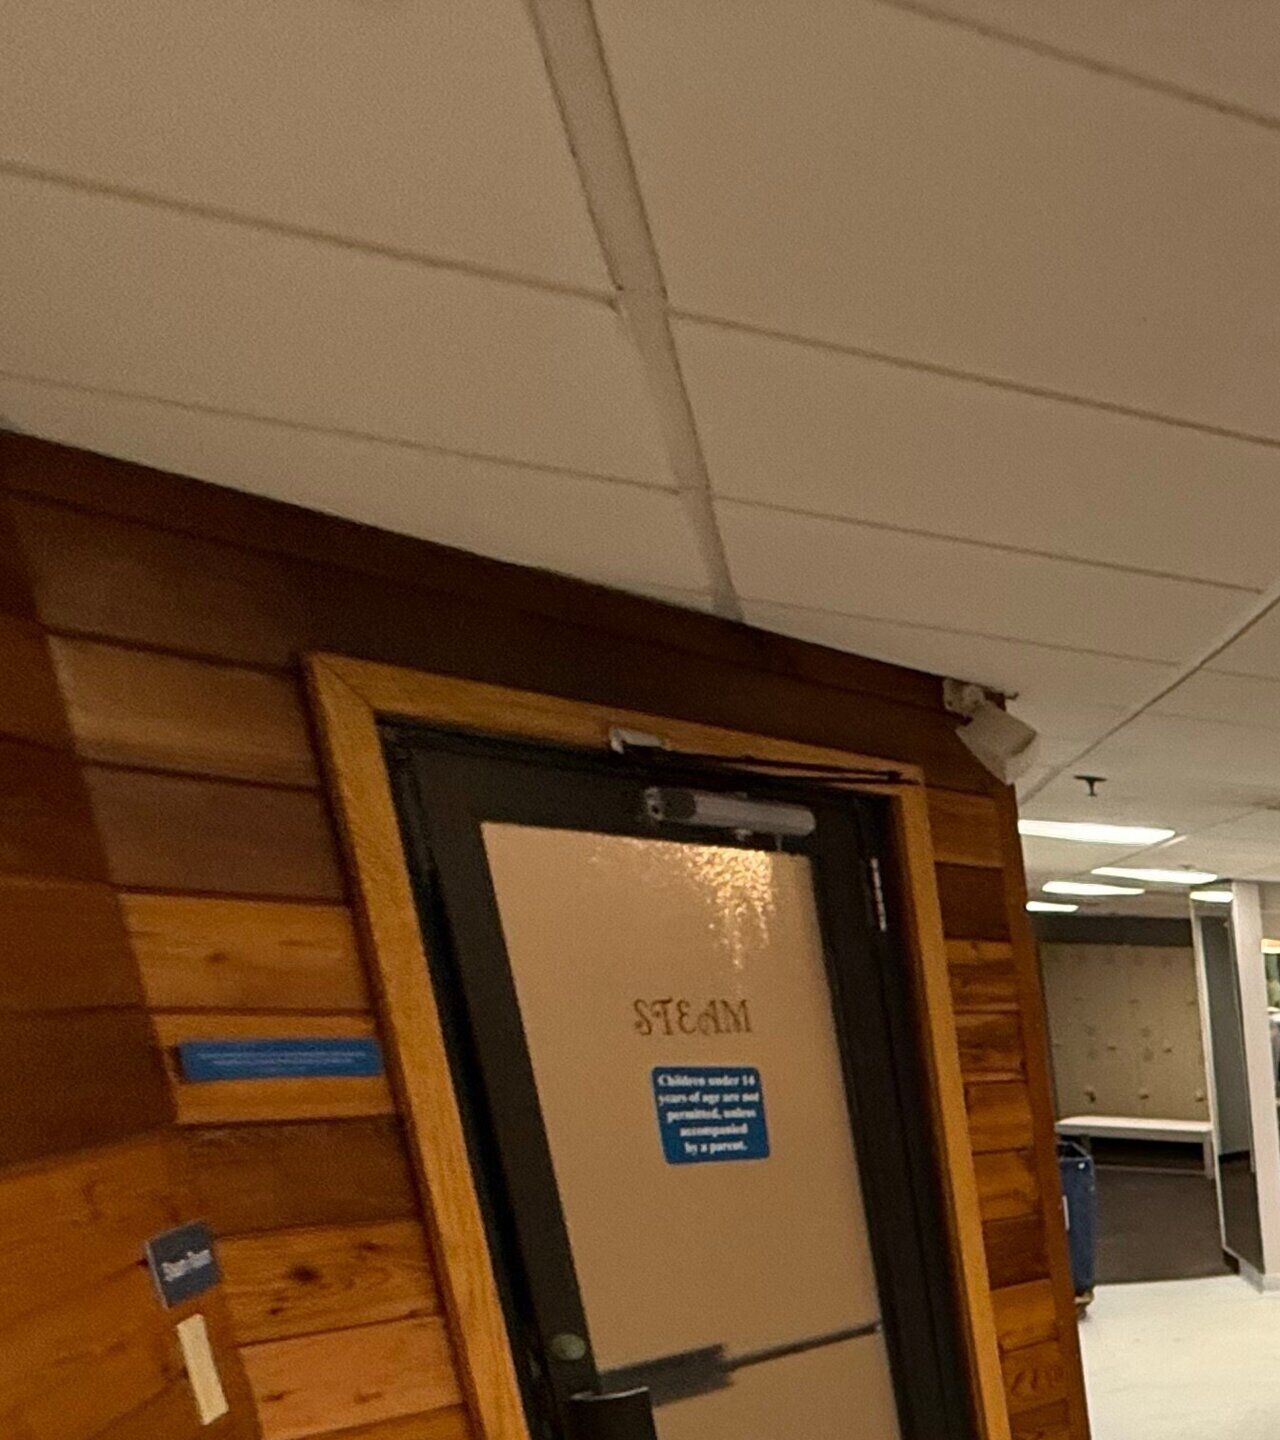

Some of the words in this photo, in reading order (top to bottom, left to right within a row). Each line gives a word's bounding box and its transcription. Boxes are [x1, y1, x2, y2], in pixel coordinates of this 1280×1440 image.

[634, 999, 752, 1036] STEAM
[658, 1075, 706, 1086] Children
[708, 1075, 740, 1086] under
[689, 1091, 700, 1102] of
